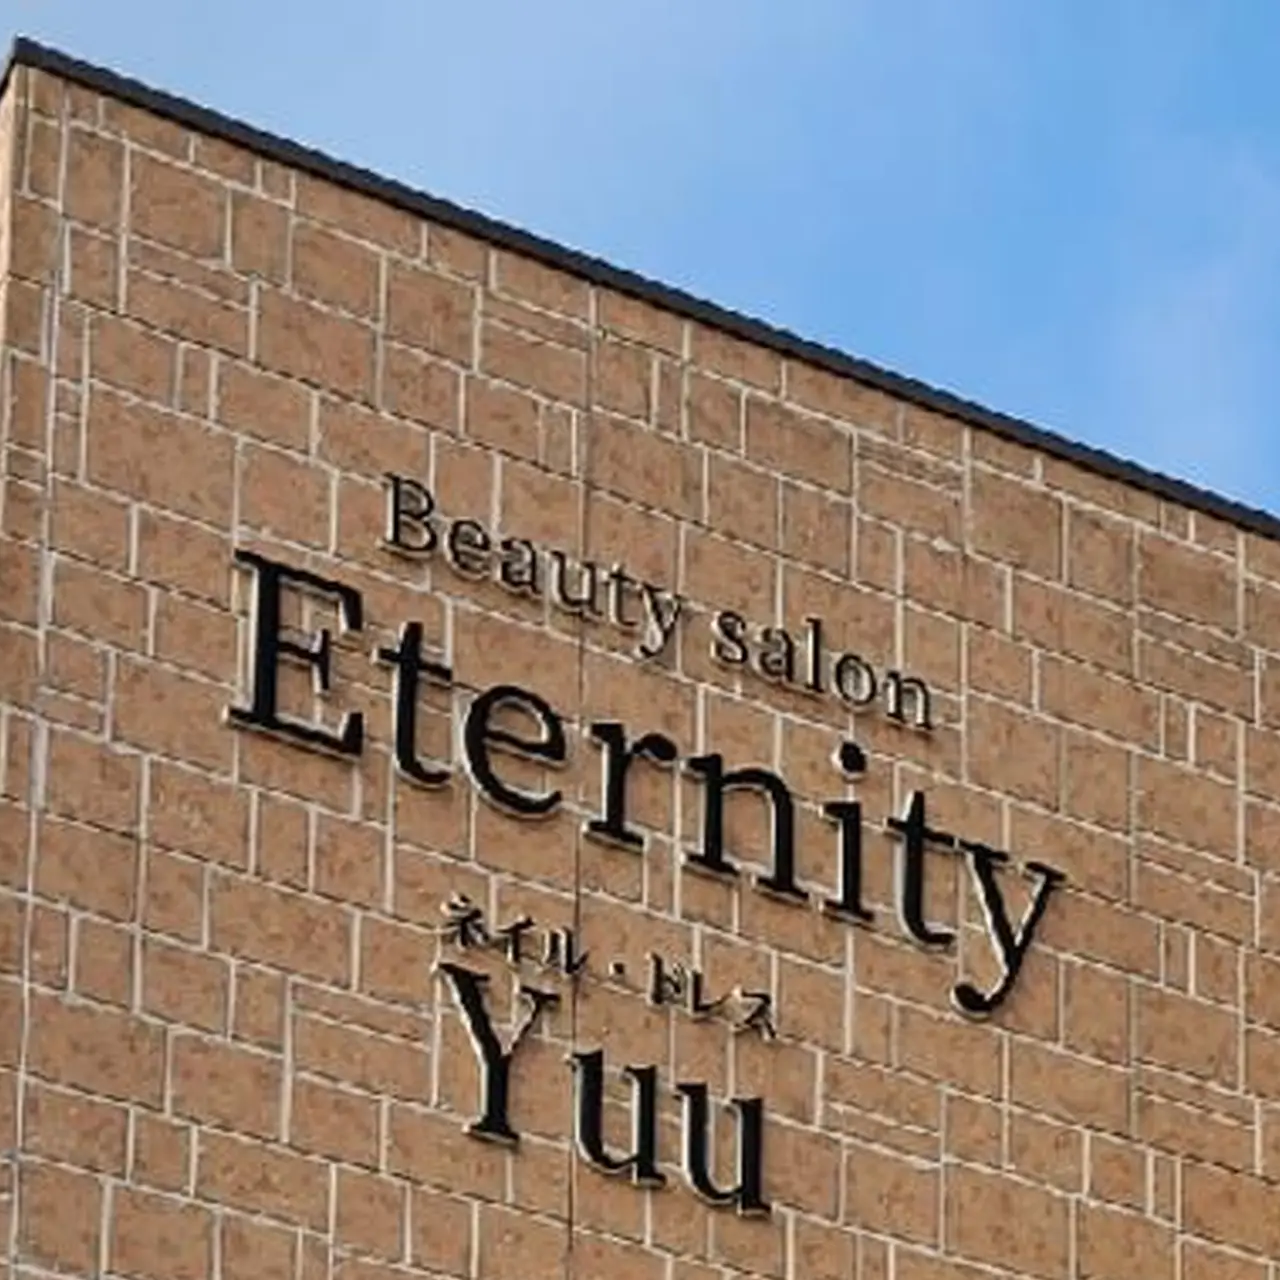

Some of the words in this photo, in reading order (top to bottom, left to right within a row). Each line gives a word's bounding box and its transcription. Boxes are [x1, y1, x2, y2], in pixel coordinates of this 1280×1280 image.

[378, 470, 683, 660] Beauty
[710, 606, 936, 734] salon
[223, 546, 1067, 1024] Eternity
[432, 960, 774, 1216] Yuu
